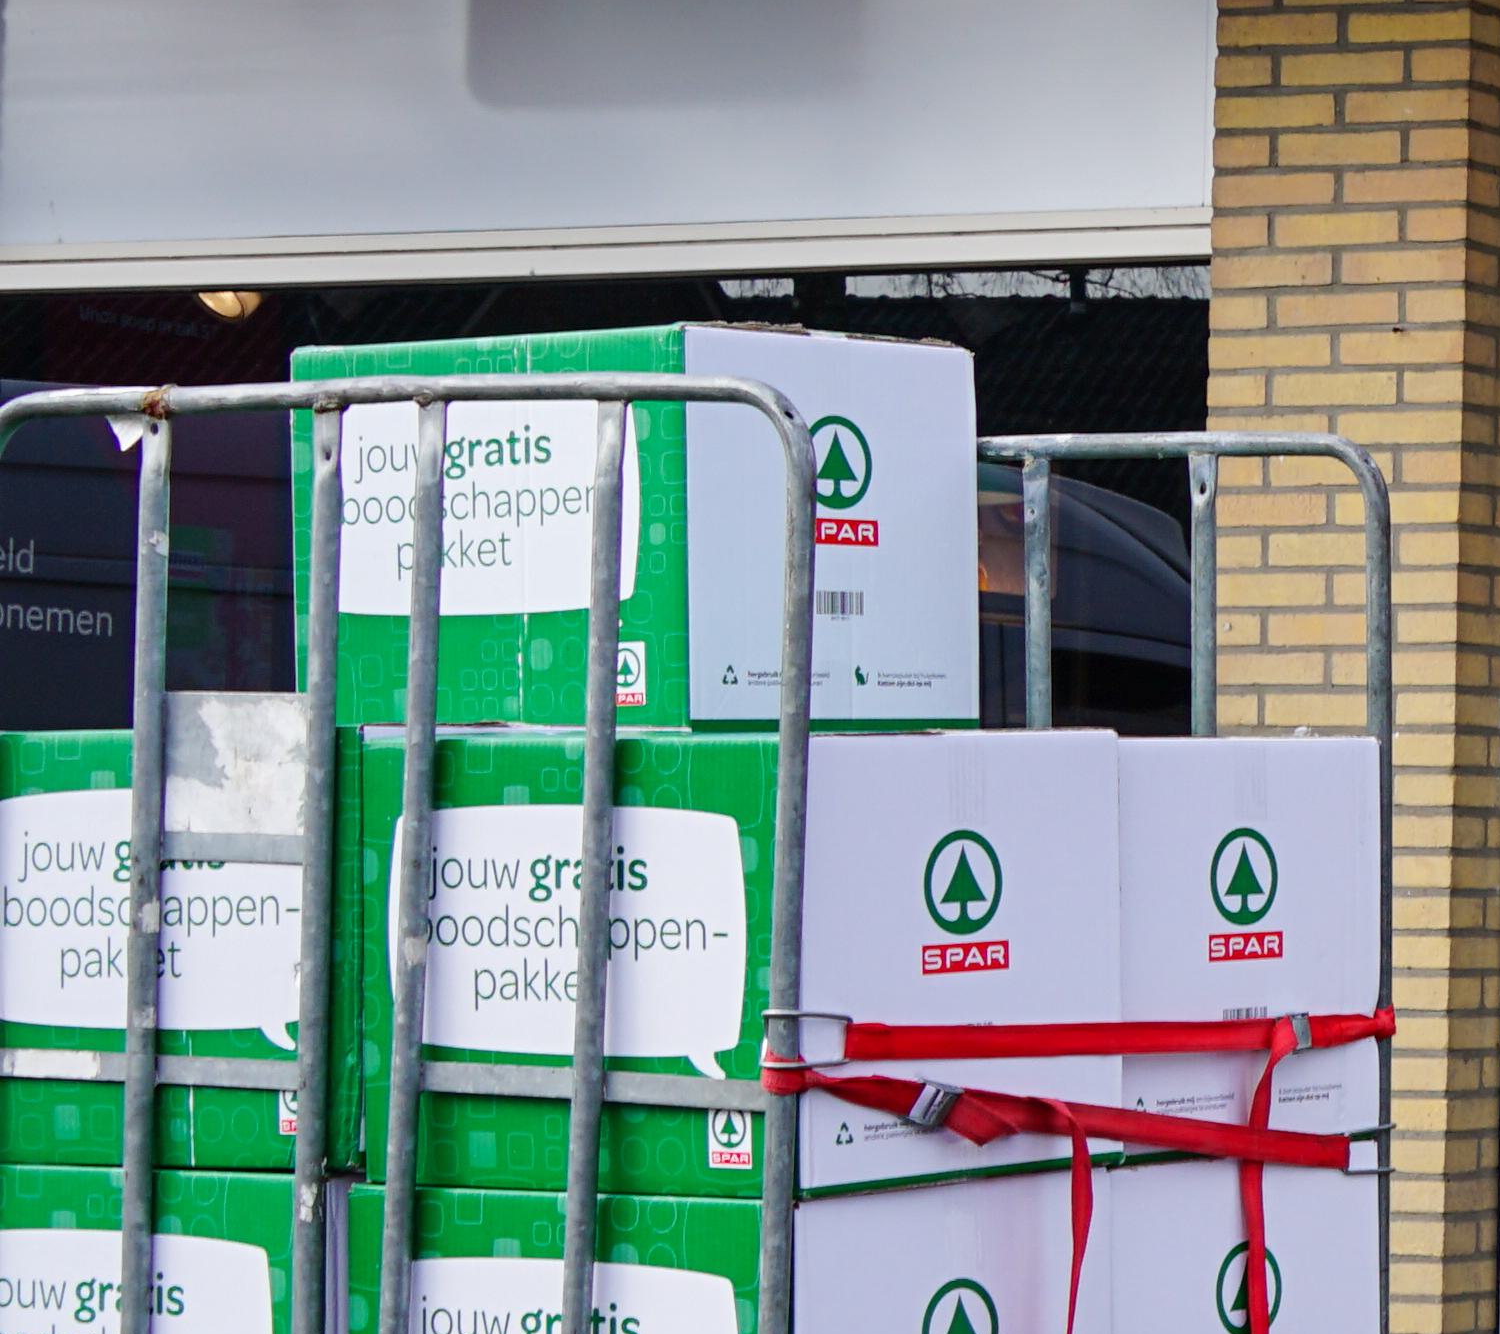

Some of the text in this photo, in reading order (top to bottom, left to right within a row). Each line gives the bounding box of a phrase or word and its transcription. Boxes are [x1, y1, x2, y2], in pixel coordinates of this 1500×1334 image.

[444, 424, 552, 480] gratis
[397, 529, 511, 581] pkket
[816, 521, 875, 543] PAR
[0, 603, 113, 637] nemen
[616, 693, 644, 705] PAR
[17, 831, 106, 883] jouw
[429, 847, 521, 899] jouw
[3, 885, 301, 938] boodscappen-
[427, 904, 729, 962] oodschppen-
[60, 937, 182, 989] pakt
[923, 942, 1007, 971] SPAR
[1209, 933, 1280, 958] SPAR
[475, 958, 579, 1011] pakke
[712, 1152, 750, 1165] SPAR
[0, 1278, 66, 1310] ouw
